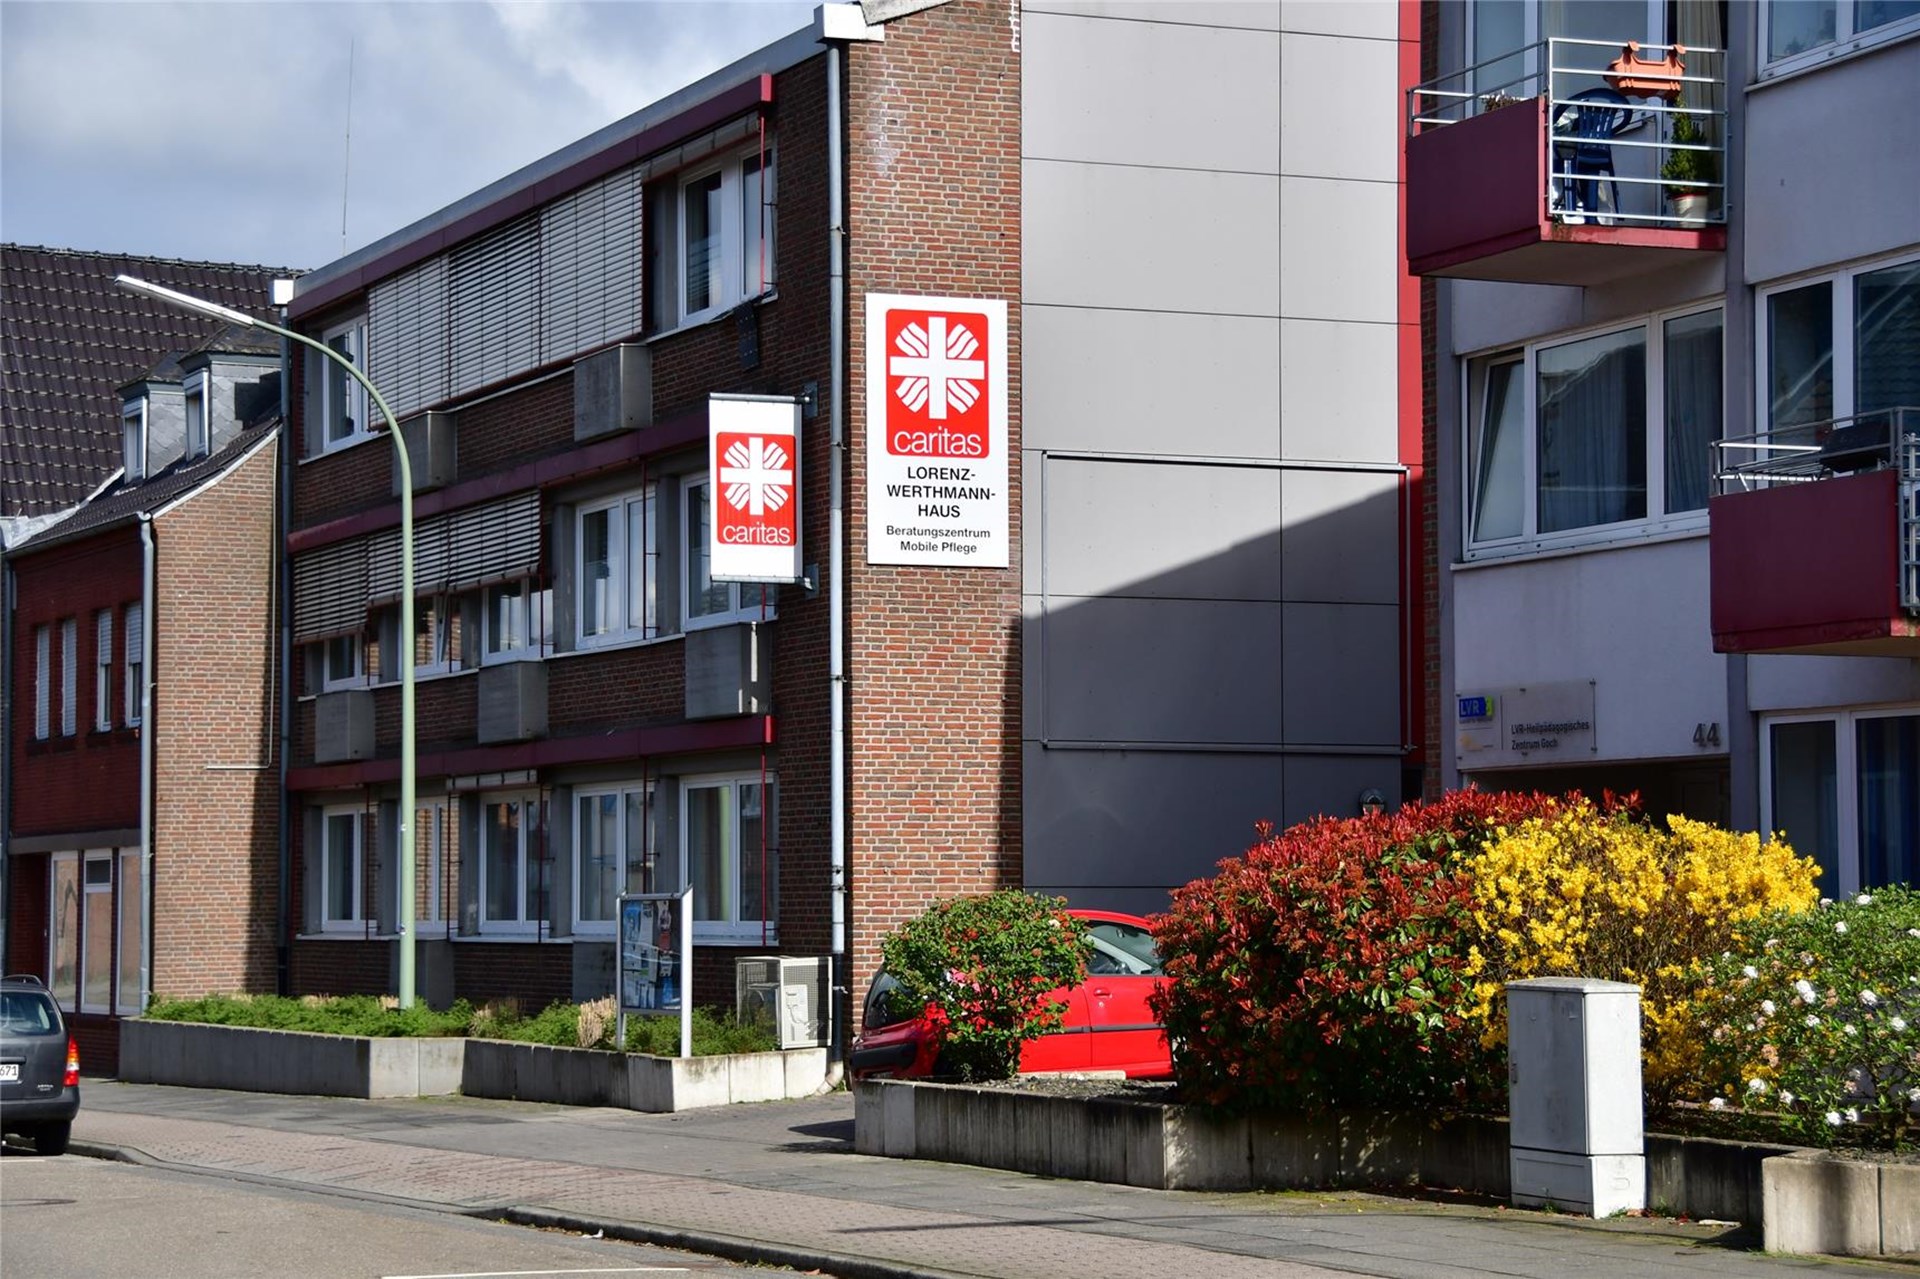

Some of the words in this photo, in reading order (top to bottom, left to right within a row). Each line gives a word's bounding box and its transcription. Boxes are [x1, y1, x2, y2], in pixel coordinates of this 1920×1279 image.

[893, 426, 982, 456] caritas
[907, 466, 976, 481] LORENZ-
[886, 484, 996, 500] WERTHMANN-
[918, 504, 961, 518] HAUS
[722, 521, 791, 545] caritas
[886, 525, 991, 539] Beratungszentrum
[900, 541, 938, 552] Mobile
[941, 541, 977, 555] Pflege
[1460, 699, 1480, 716] LVR
[1511, 720, 1590, 735] LVR-Heilpädagogisches
[1692, 722, 1721, 748] 44
[1511, 740, 1540, 751] Zentrum
[1540, 738, 1558, 750] Goch
